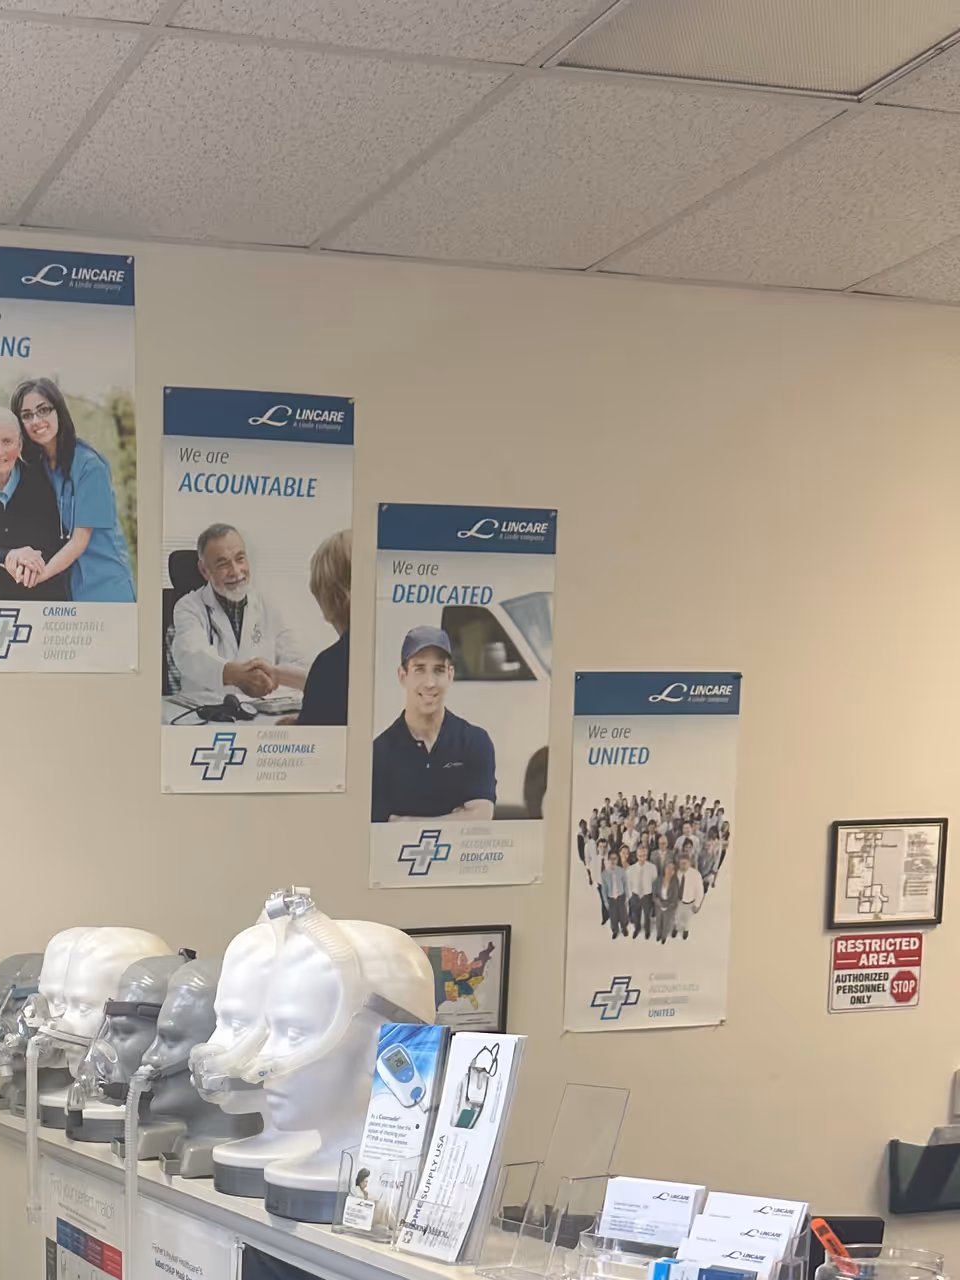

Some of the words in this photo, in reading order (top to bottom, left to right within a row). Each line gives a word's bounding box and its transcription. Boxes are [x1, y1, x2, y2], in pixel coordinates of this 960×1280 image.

[71, 267, 125, 282] LINCARE
[295, 408, 345, 423] LINCARE
[179, 447, 201, 463] We
[206, 451, 230, 464] are
[178, 472, 318, 498] ACCOUNTABLE
[501, 521, 549, 534] LINCARE
[392, 560, 413, 575] We
[417, 563, 439, 576] are
[392, 584, 493, 605] DEDICATED
[42, 606, 77, 616] CARING
[689, 685, 733, 695] LINCARE
[588, 724, 608, 739] We
[611, 727, 631, 739] are
[256, 744, 316, 754] ACCOUNTABLE
[588, 746, 650, 765] UNITED
[460, 852, 504, 862] DEDICATED
[837, 937, 920, 953] RESTRICTED
[859, 952, 896, 966] AREA
[835, 972, 890, 984] AUTHORIZED
[836, 984, 886, 995] PERSONNEL
[892, 980, 915, 993] STOP
[850, 995, 871, 1005] ONLY
[648, 1008, 675, 1018] UNITED
[421, 1159, 438, 1200] SUPPLY
[435, 1134, 446, 1157] USA
[773, 1207, 794, 1215] LINCARE
[759, 1230, 782, 1238] LINCARE
[742, 1252, 766, 1261] LINCARE
